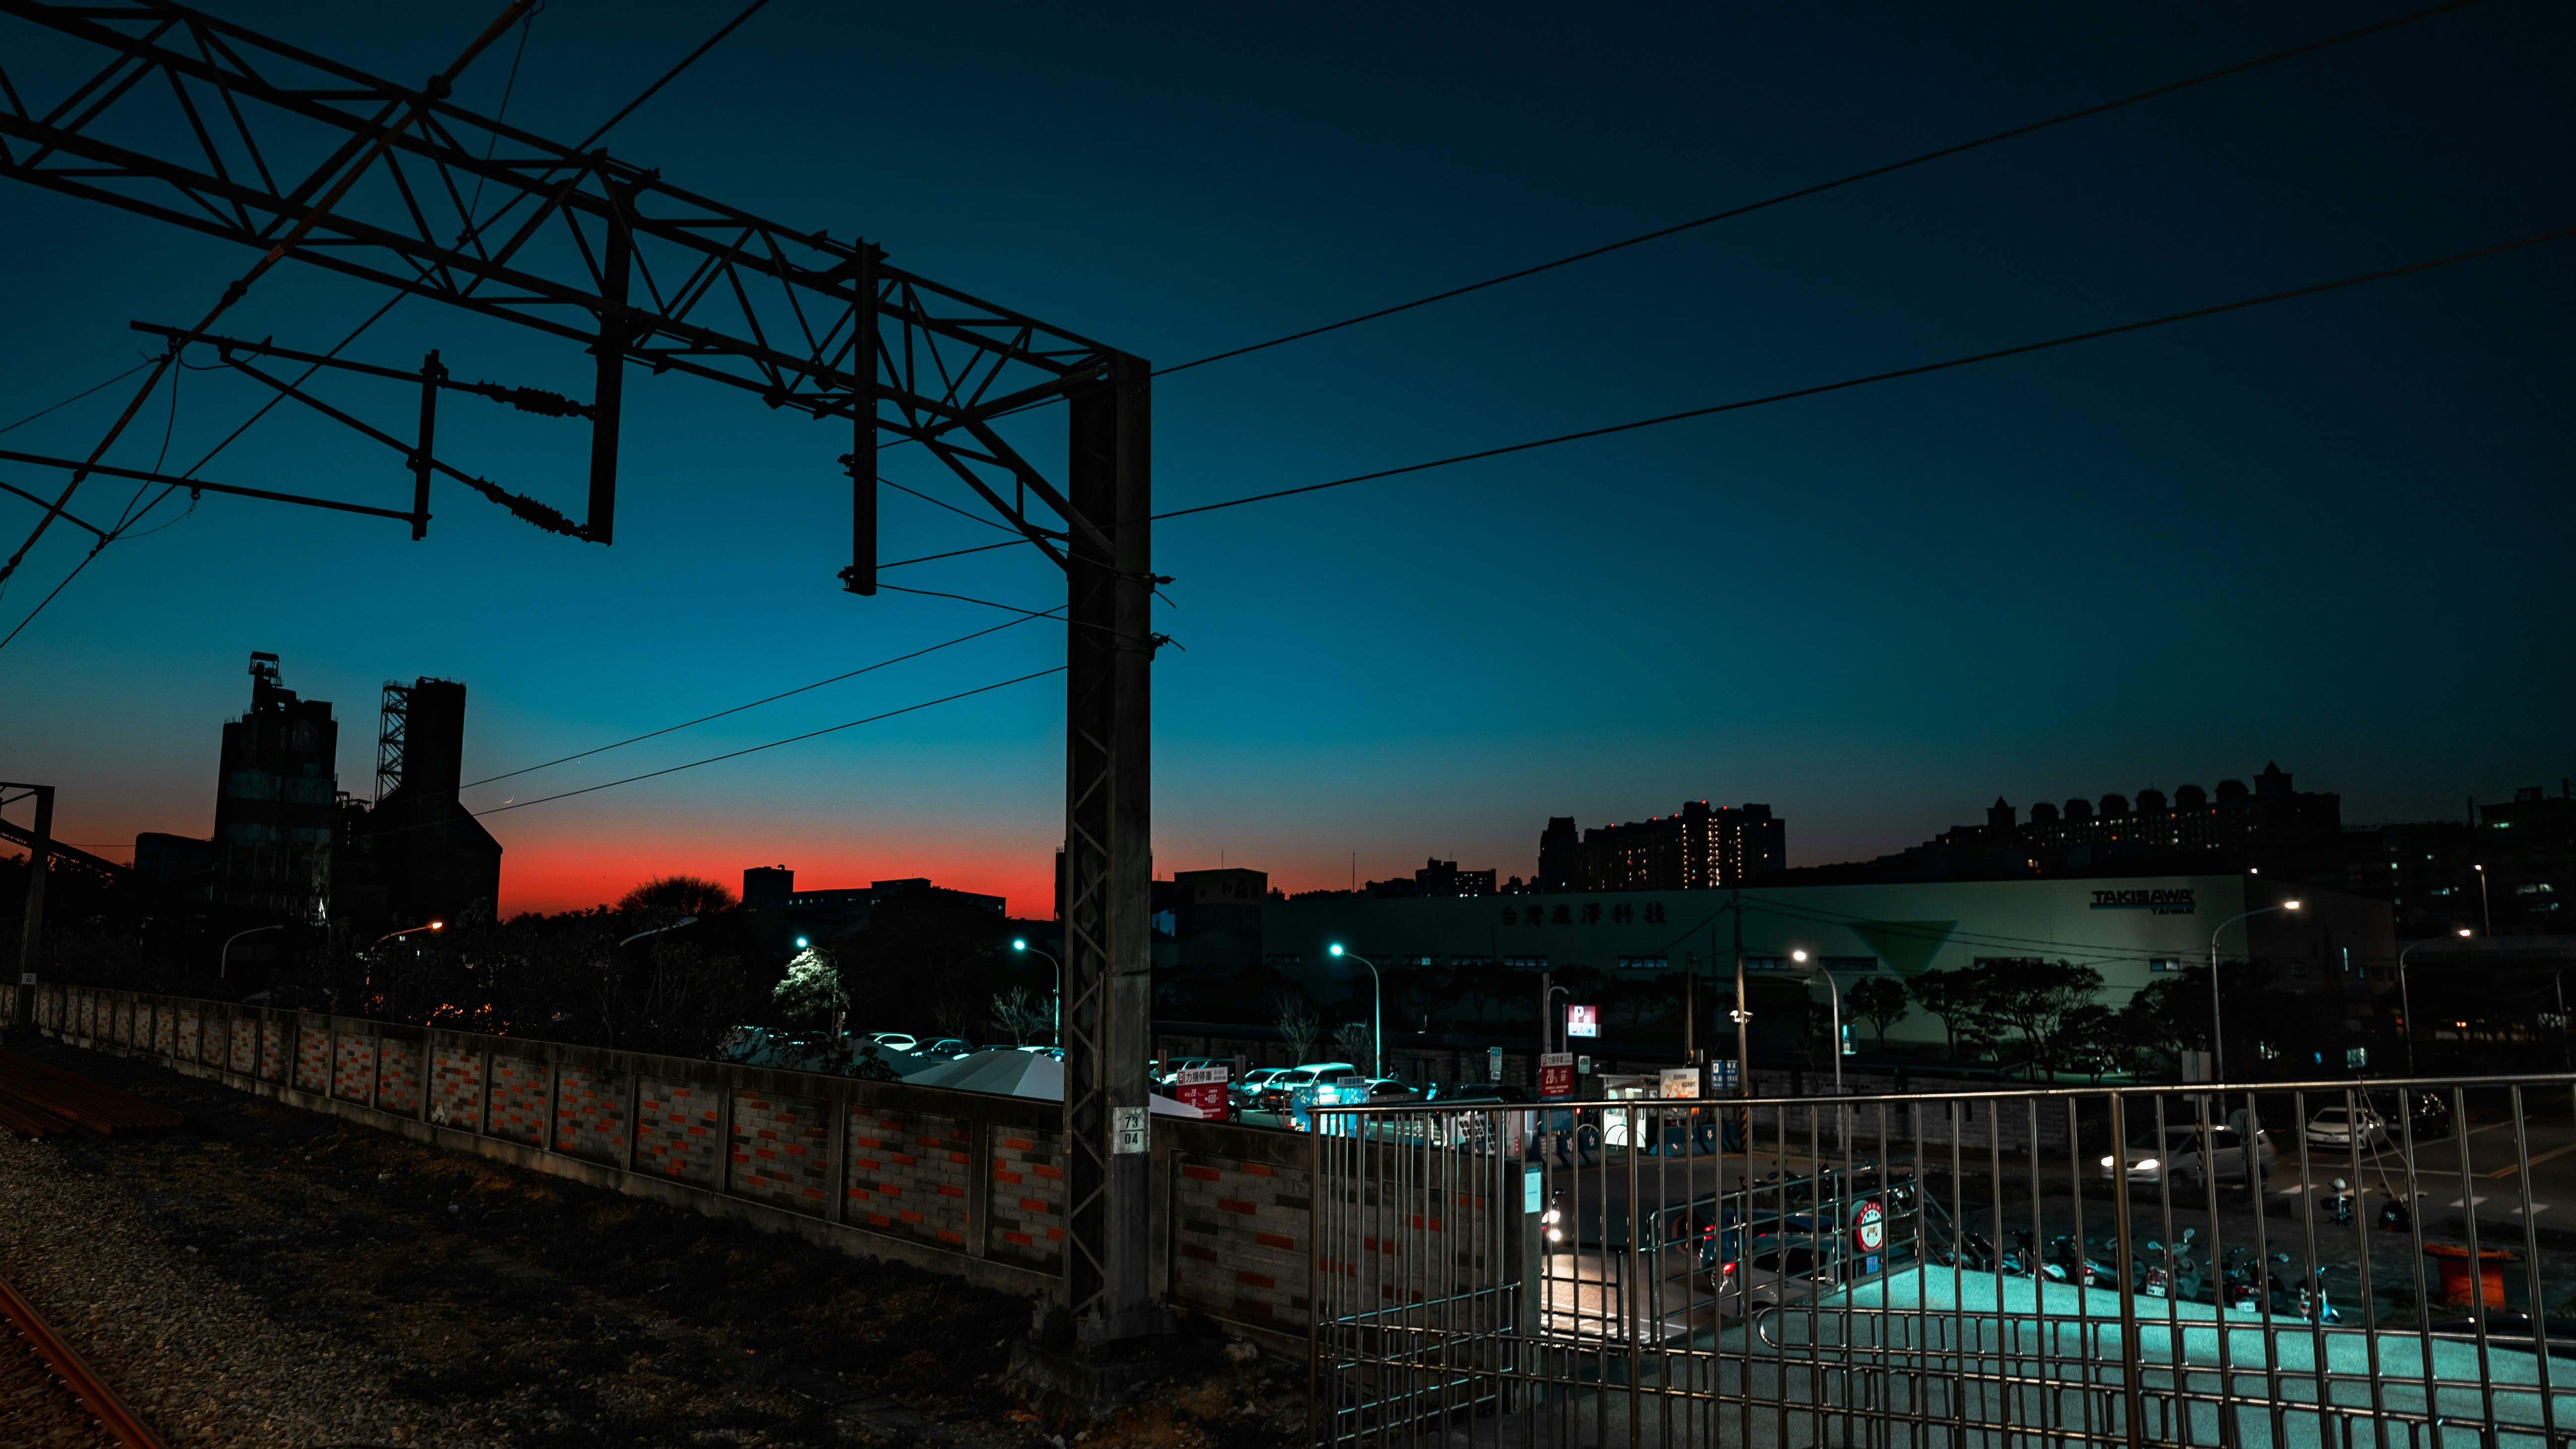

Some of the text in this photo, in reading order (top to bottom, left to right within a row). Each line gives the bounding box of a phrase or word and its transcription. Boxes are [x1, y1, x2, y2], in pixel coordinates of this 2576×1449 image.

[2092, 890, 2192, 902] TAKISAWA
[1186, 1071, 1212, 1083] 力揚停車
[1125, 1116, 1138, 1128] 73
[1125, 1133, 1138, 1144] 04
